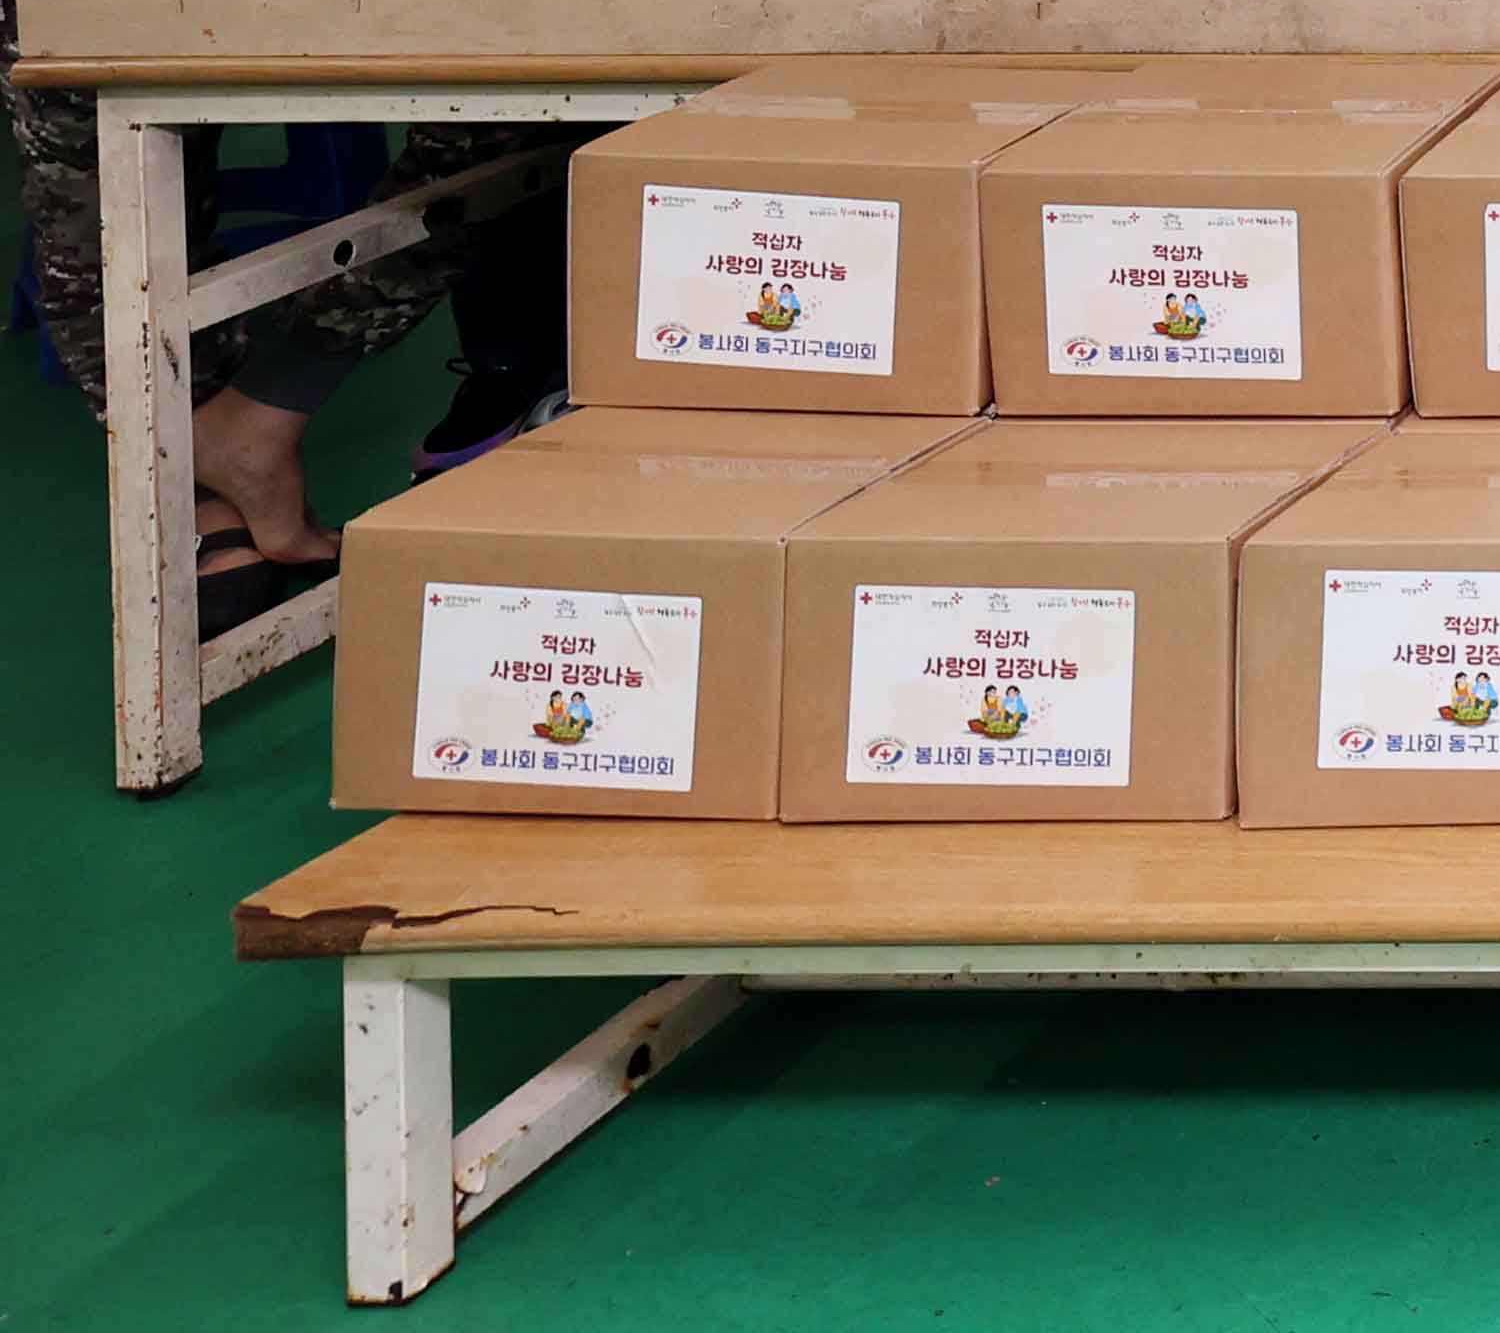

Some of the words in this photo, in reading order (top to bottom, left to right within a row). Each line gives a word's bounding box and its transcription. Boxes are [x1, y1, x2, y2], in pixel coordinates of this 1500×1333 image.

[1150, 244, 1204, 262] 적십자
[1107, 267, 1166, 288] 사랑의
[1172, 268, 1250, 289] 김장나눔
[1107, 344, 1159, 363] 봉사회
[1163, 345, 1285, 365] 동구지구협의회
[1442, 615, 1500, 636] 적십자
[539, 633, 597, 656] 적십자
[1391, 643, 1456, 666] 사랑의
[488, 659, 553, 684] 사랑의
[559, 662, 645, 689] 김장나눔
[1384, 733, 1442, 754] 봉사회
[479, 747, 536, 770] 봉사회
[541, 750, 675, 777] 동구지구협의회
